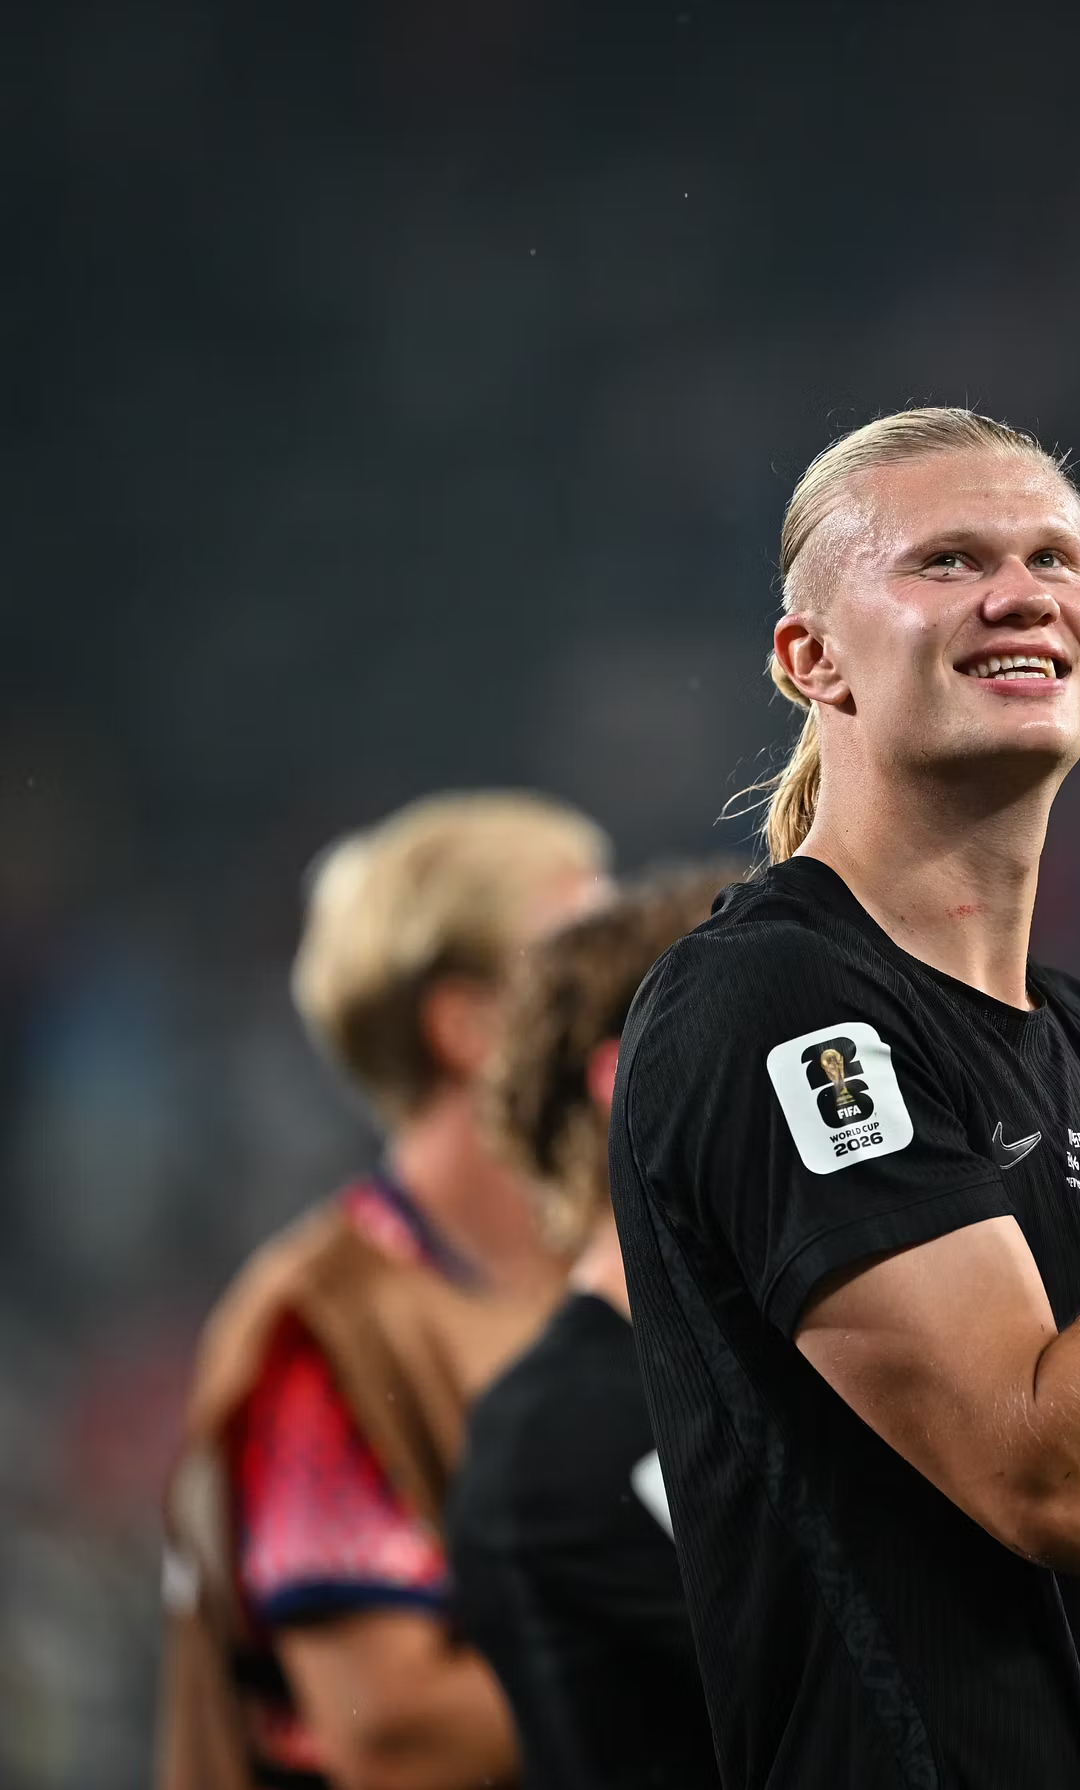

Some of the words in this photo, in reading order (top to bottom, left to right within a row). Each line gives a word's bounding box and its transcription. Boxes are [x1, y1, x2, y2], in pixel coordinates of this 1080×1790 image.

[837, 1105, 862, 1119] FIFA
[830, 1128, 861, 1143] WORLD
[862, 1122, 879, 1132] CUP
[834, 1132, 883, 1157] 2026
